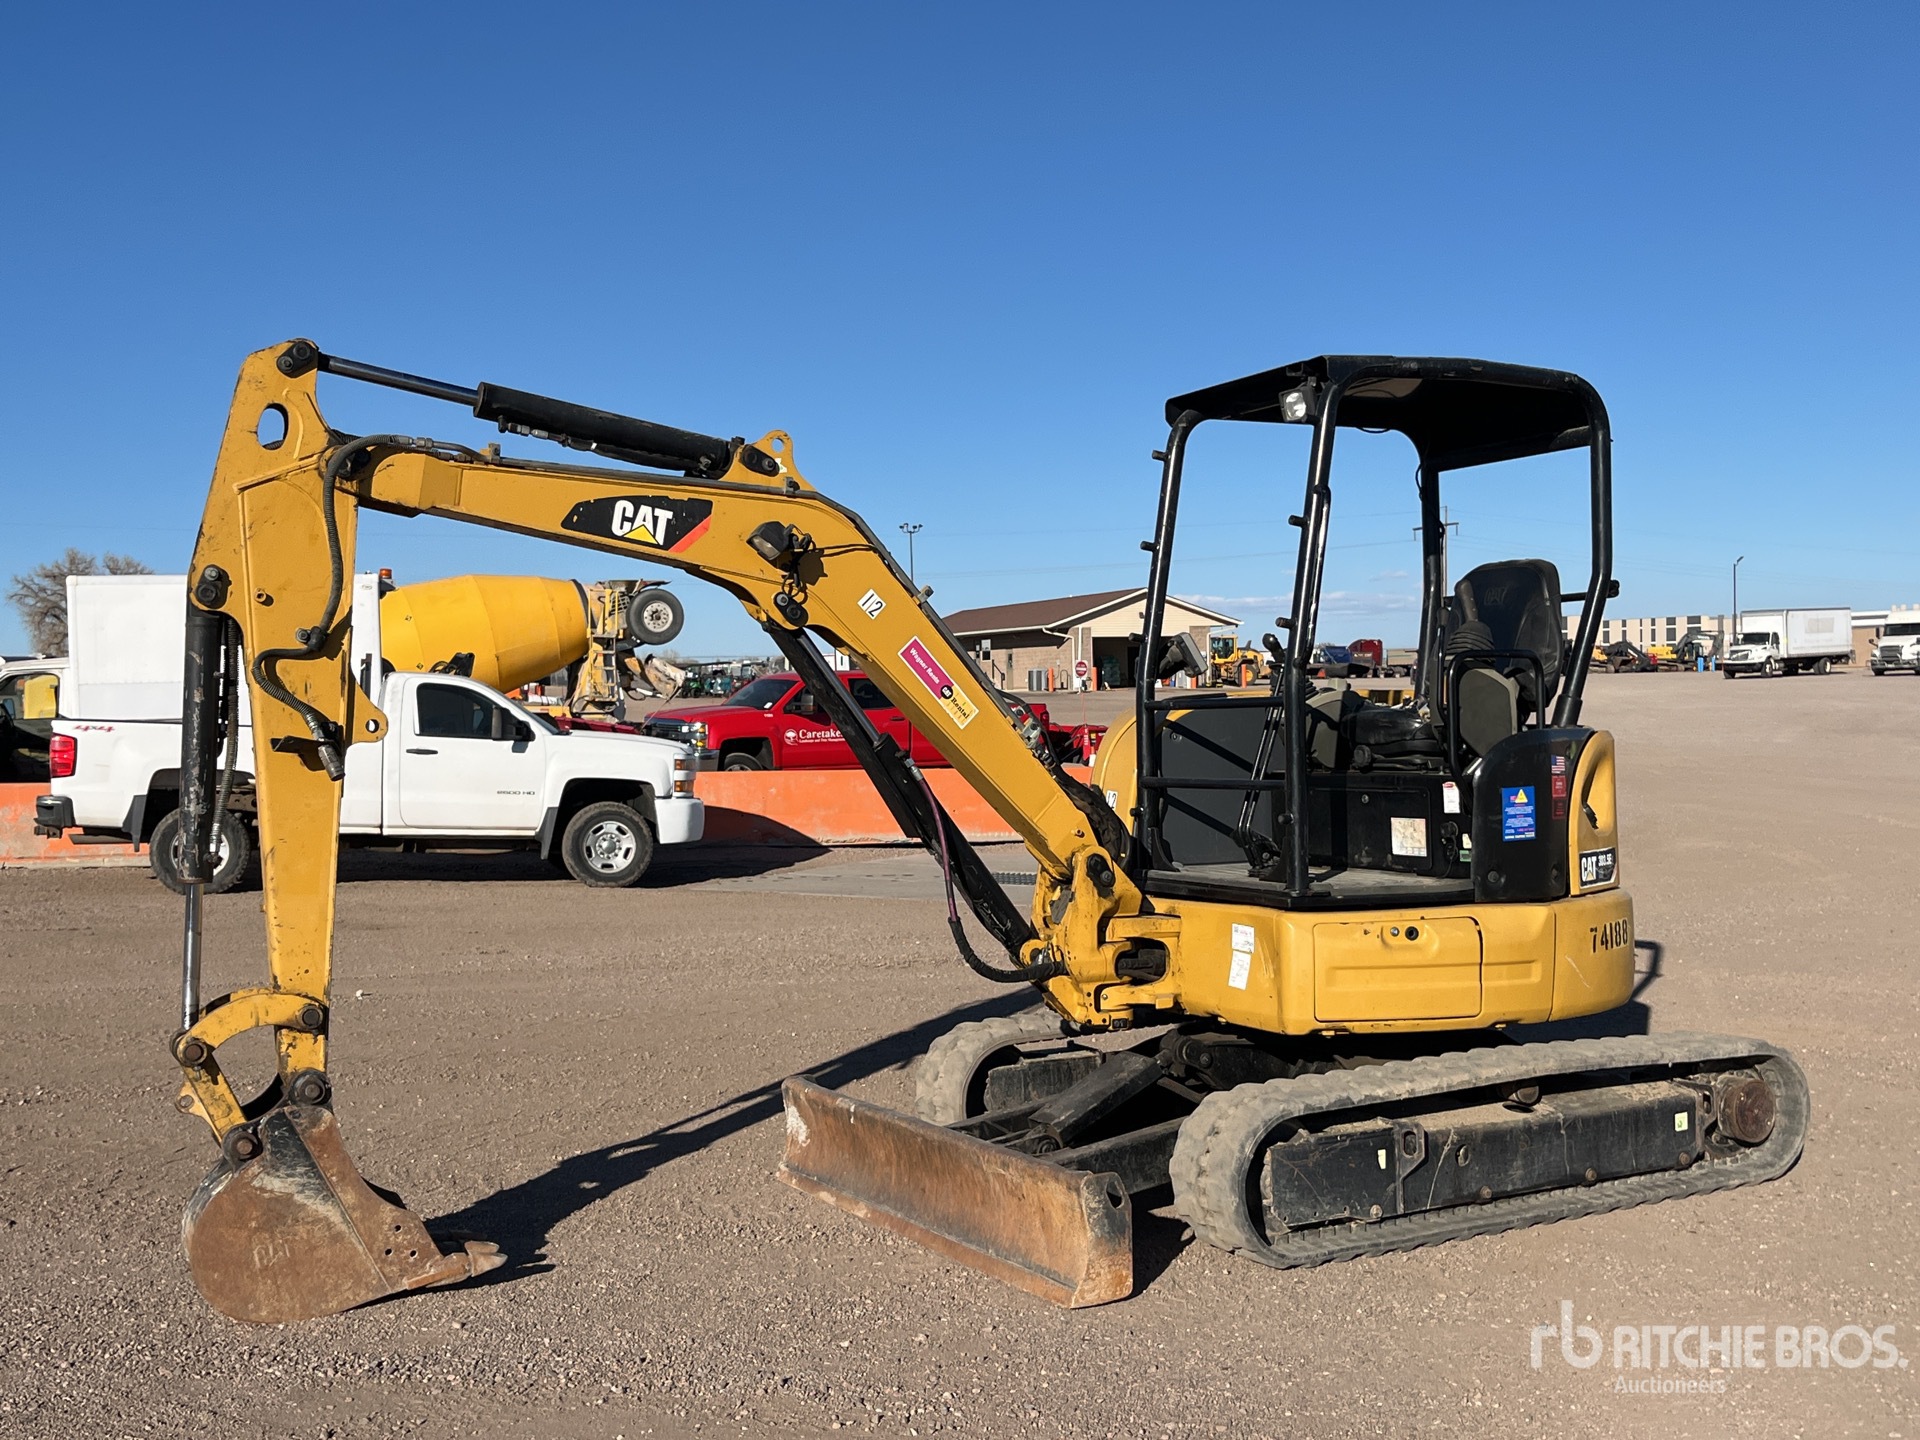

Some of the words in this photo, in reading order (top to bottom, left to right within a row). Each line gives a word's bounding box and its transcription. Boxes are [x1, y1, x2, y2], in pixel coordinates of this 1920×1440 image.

[611, 500, 673, 546] CAT
[909, 647, 928, 672] Wagner
[951, 696, 970, 719] Rental
[799, 729, 843, 739] Caretake
[1581, 856, 1597, 882] CAT
[1590, 919, 1628, 953] 74188
